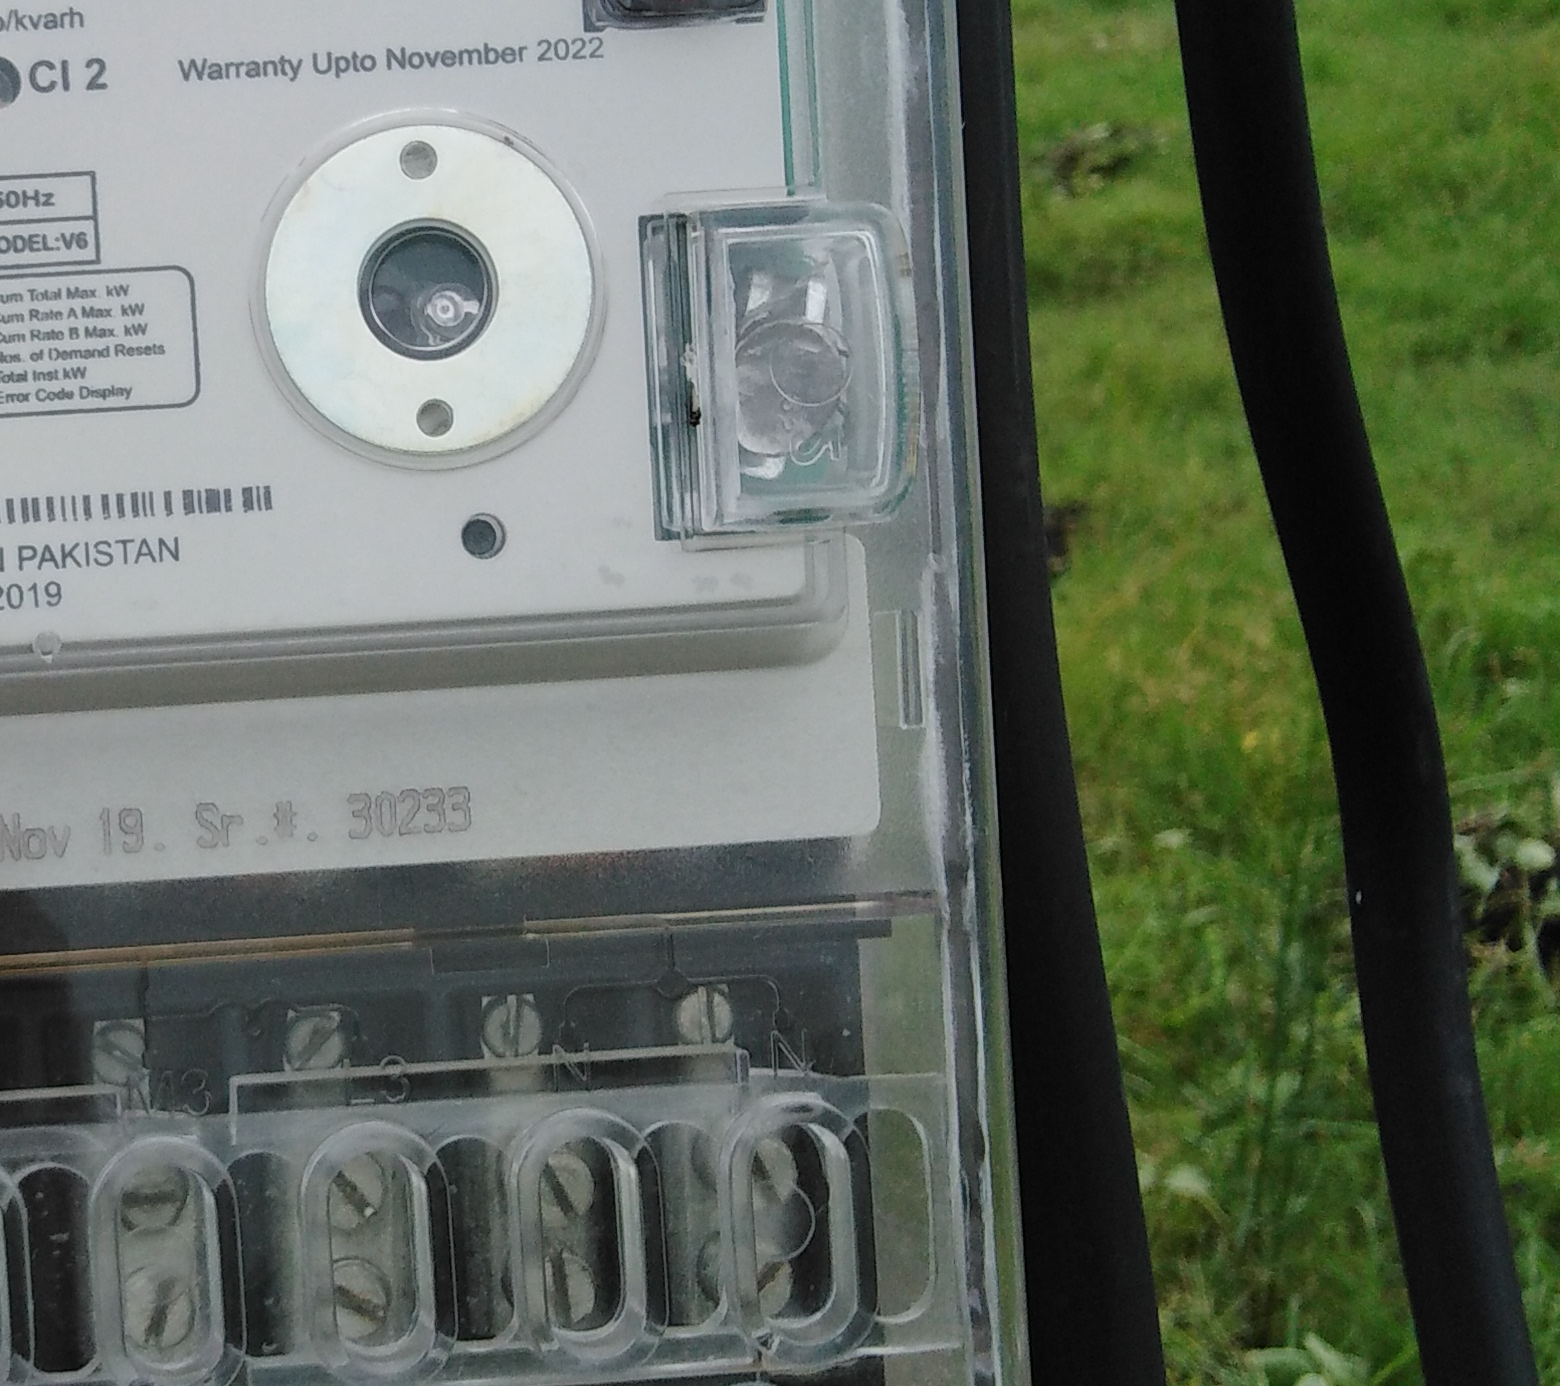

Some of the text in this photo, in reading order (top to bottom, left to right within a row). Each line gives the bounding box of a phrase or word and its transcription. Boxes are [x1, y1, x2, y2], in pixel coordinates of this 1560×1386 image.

[179, 37, 604, 82] Warranty Upto November 2022
[85, 59, 108, 91] 2
[28, 288, 62, 302] Total
[106, 284, 129, 298] kW
[29, 309, 63, 322] Rate
[67, 308, 78, 320] A
[121, 303, 145, 317] kW
[70, 327, 79, 340] B
[124, 323, 148, 337] kW
[30, 349, 44, 362] of
[49, 345, 110, 361] Demand
[114, 343, 165, 357] Resets
[36, 388, 74, 402] Code
[79, 385, 132, 401] Display
[17, 537, 181, 572] PAKISTAN
[348, 787, 472, 839] 30233
